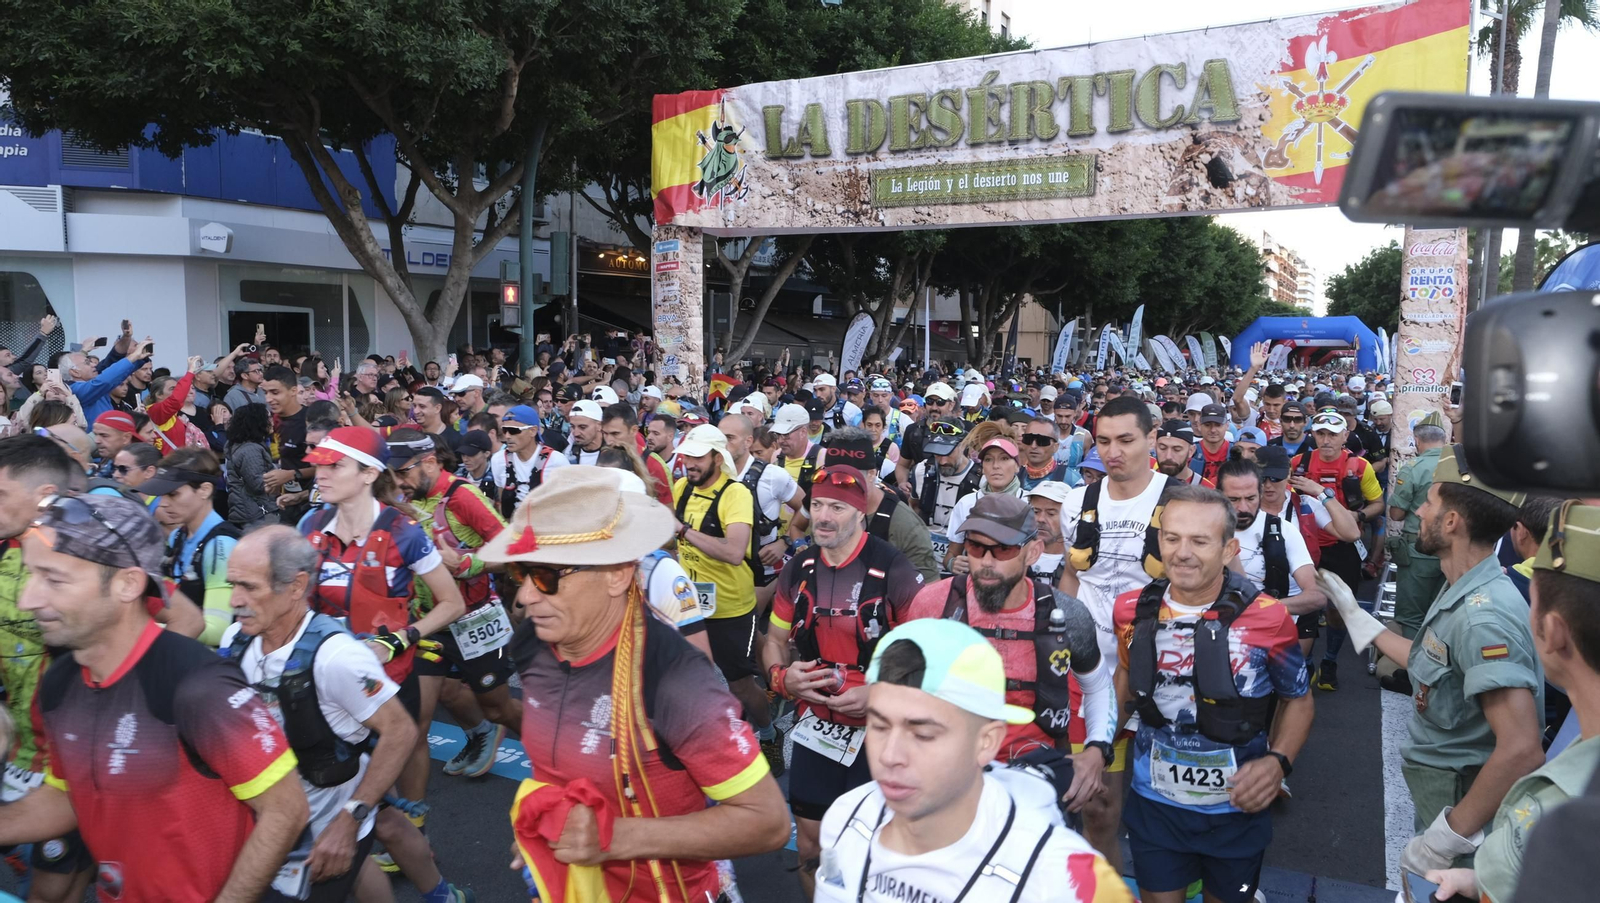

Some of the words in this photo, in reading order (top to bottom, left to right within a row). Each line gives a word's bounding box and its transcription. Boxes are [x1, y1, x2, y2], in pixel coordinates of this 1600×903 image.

[762, 102, 832, 157] LA
[845, 57, 1242, 155] DESÉRTICA
[891, 178, 903, 193] La
[906, 175, 941, 194] Legión
[946, 178, 953, 193] y
[958, 174, 968, 189] el
[973, 169, 1017, 188] desierto
[1022, 171, 1042, 186] nos
[1048, 169, 1069, 184] une
[1409, 275, 1454, 286] RENTA
[1410, 267, 1454, 275] GRUPO
[1409, 286, 1454, 300] TODO
[1401, 384, 1449, 394] primaflor
[467, 618, 504, 645] 5502
[812, 718, 858, 745] 5334
[1168, 764, 1226, 788] 1423
